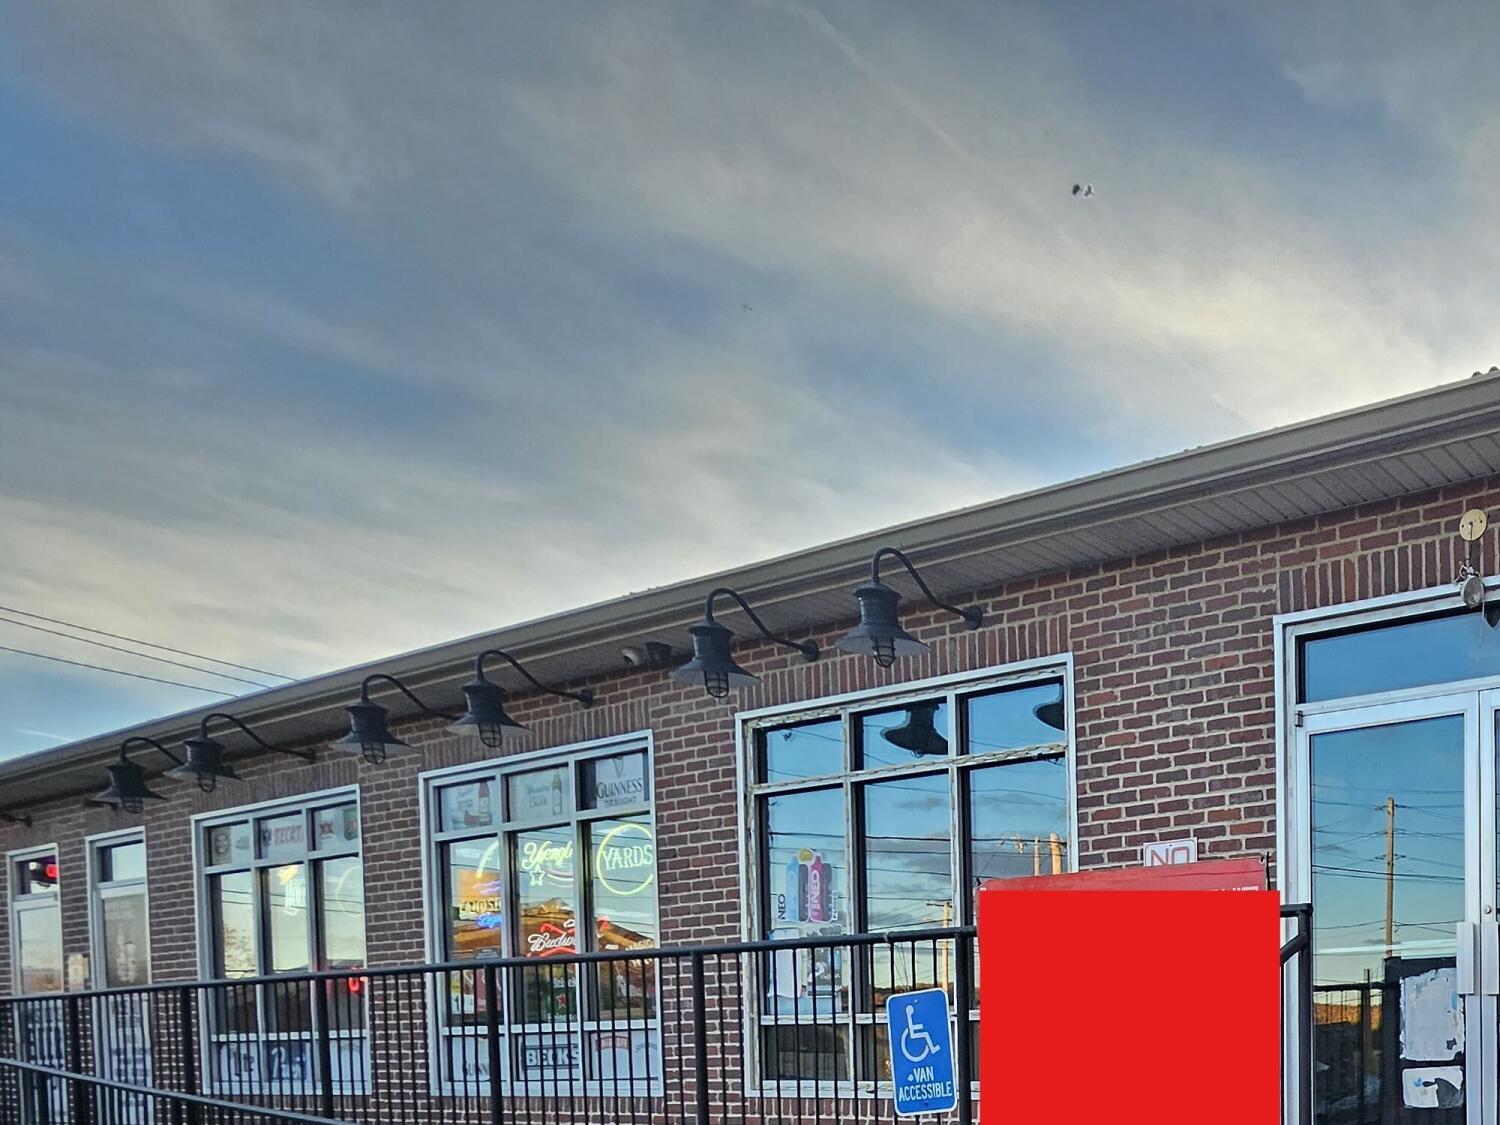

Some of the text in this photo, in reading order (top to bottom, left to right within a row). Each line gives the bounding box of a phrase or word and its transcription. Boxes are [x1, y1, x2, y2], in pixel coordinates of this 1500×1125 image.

[596, 778, 643, 799] GUINNESS
[602, 844, 653, 871] YARDS
[1151, 846, 1190, 867] NO
[777, 893, 786, 920] NEO
[913, 1066, 934, 1083] VAN
[899, 1081, 953, 1102] ACCESSIBLE
